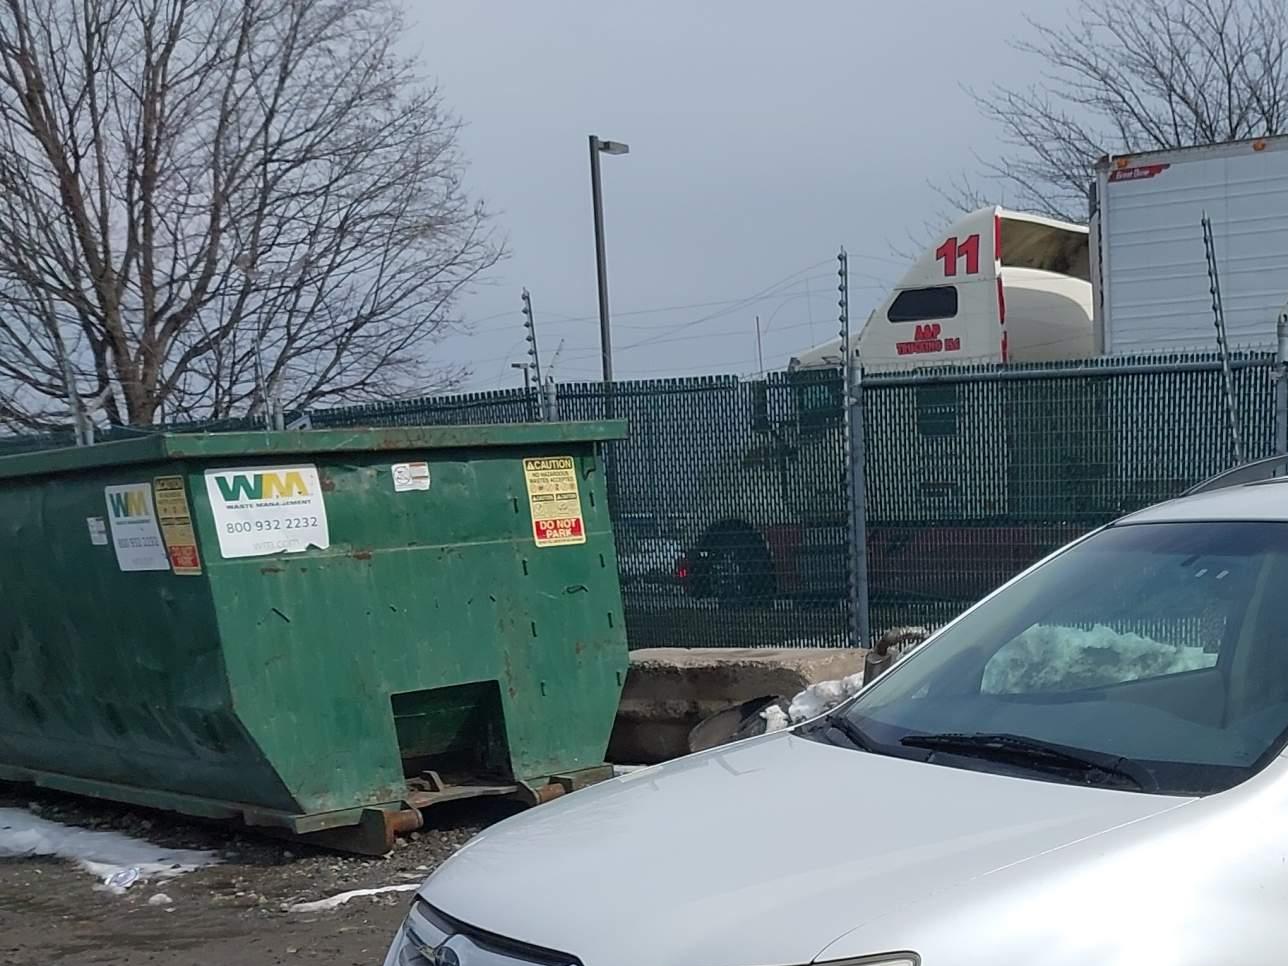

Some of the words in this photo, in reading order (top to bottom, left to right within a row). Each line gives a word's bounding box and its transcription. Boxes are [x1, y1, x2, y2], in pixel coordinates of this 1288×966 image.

[936, 234, 980, 277] 11
[534, 459, 572, 470] CAUTION
[214, 471, 309, 502] WM
[109, 490, 148, 518] WM
[226, 521, 252, 534] 800
[255, 519, 281, 532] 932
[285, 516, 318, 529] 2232
[540, 520, 555, 530] DO
[557, 518, 577, 528] NOT
[546, 528, 572, 538] PARK
